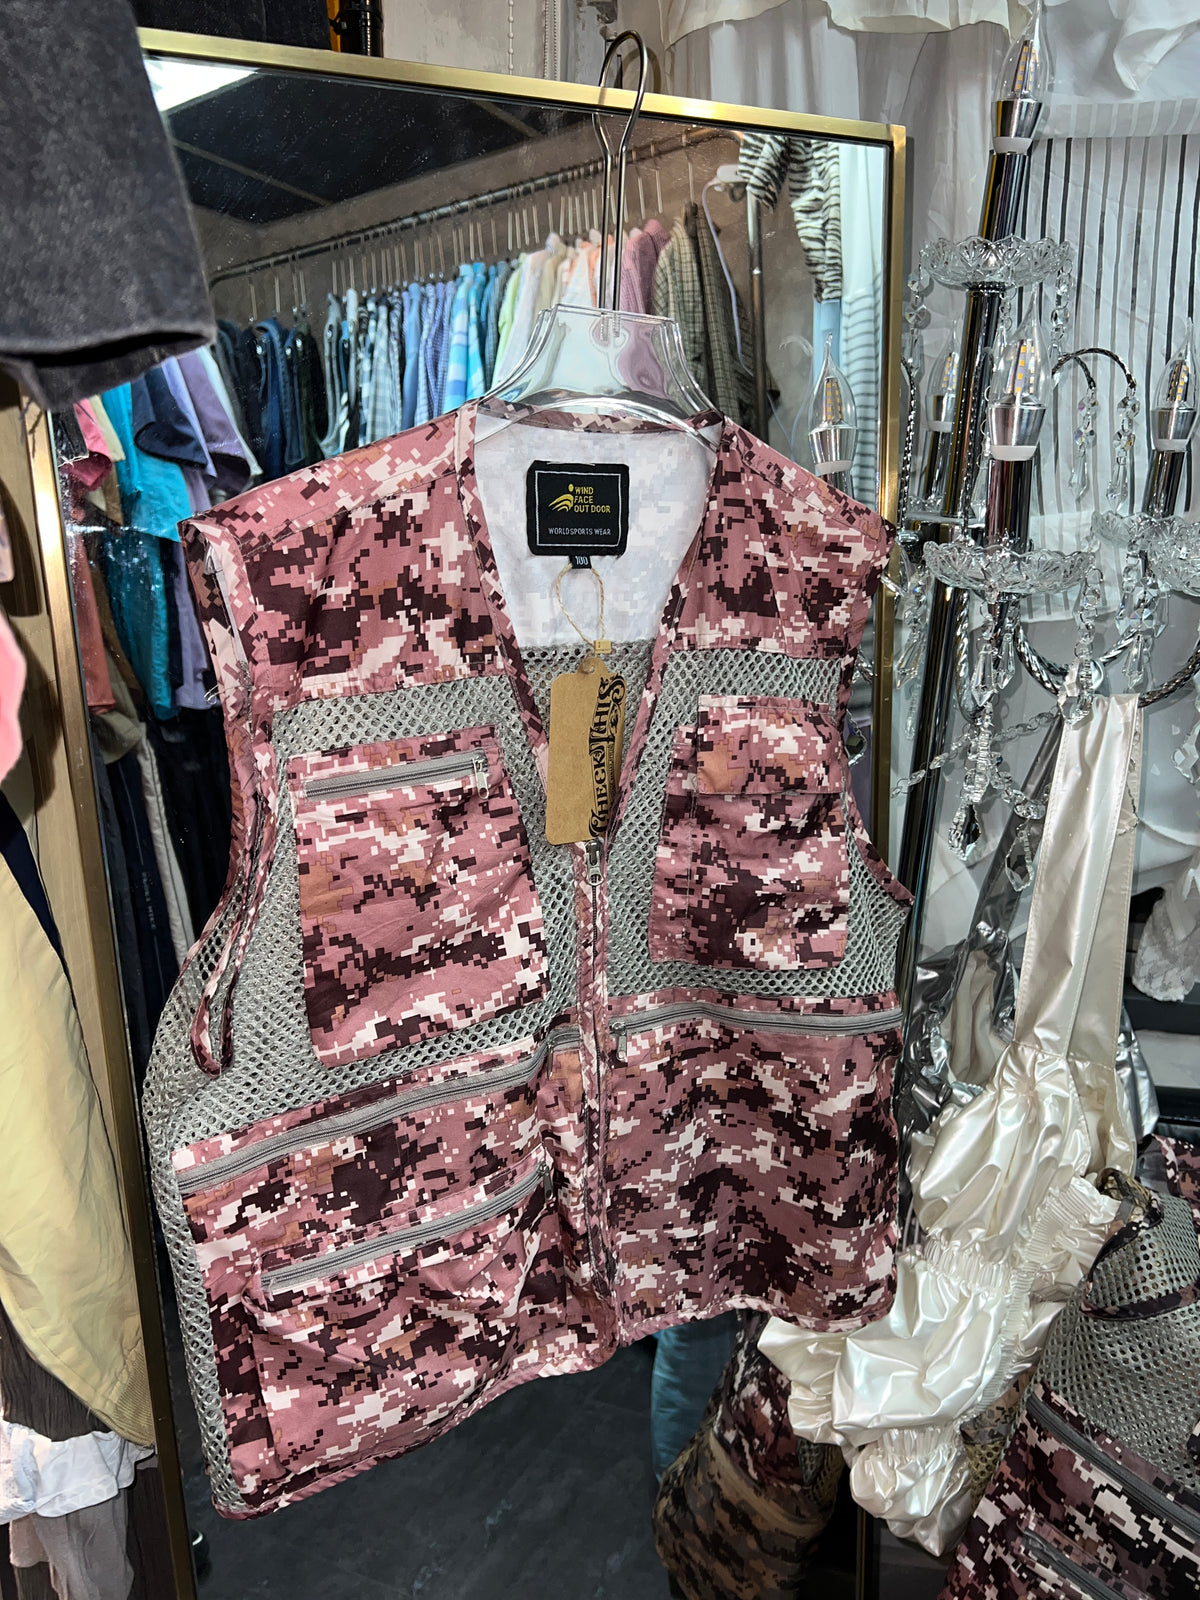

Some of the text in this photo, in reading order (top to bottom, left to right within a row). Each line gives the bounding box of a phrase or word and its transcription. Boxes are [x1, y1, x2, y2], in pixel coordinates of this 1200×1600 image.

[575, 486, 594, 495] WIND
[574, 495, 594, 504] FACE
[593, 528, 611, 536] WEAR
[575, 555, 589, 566] 100
